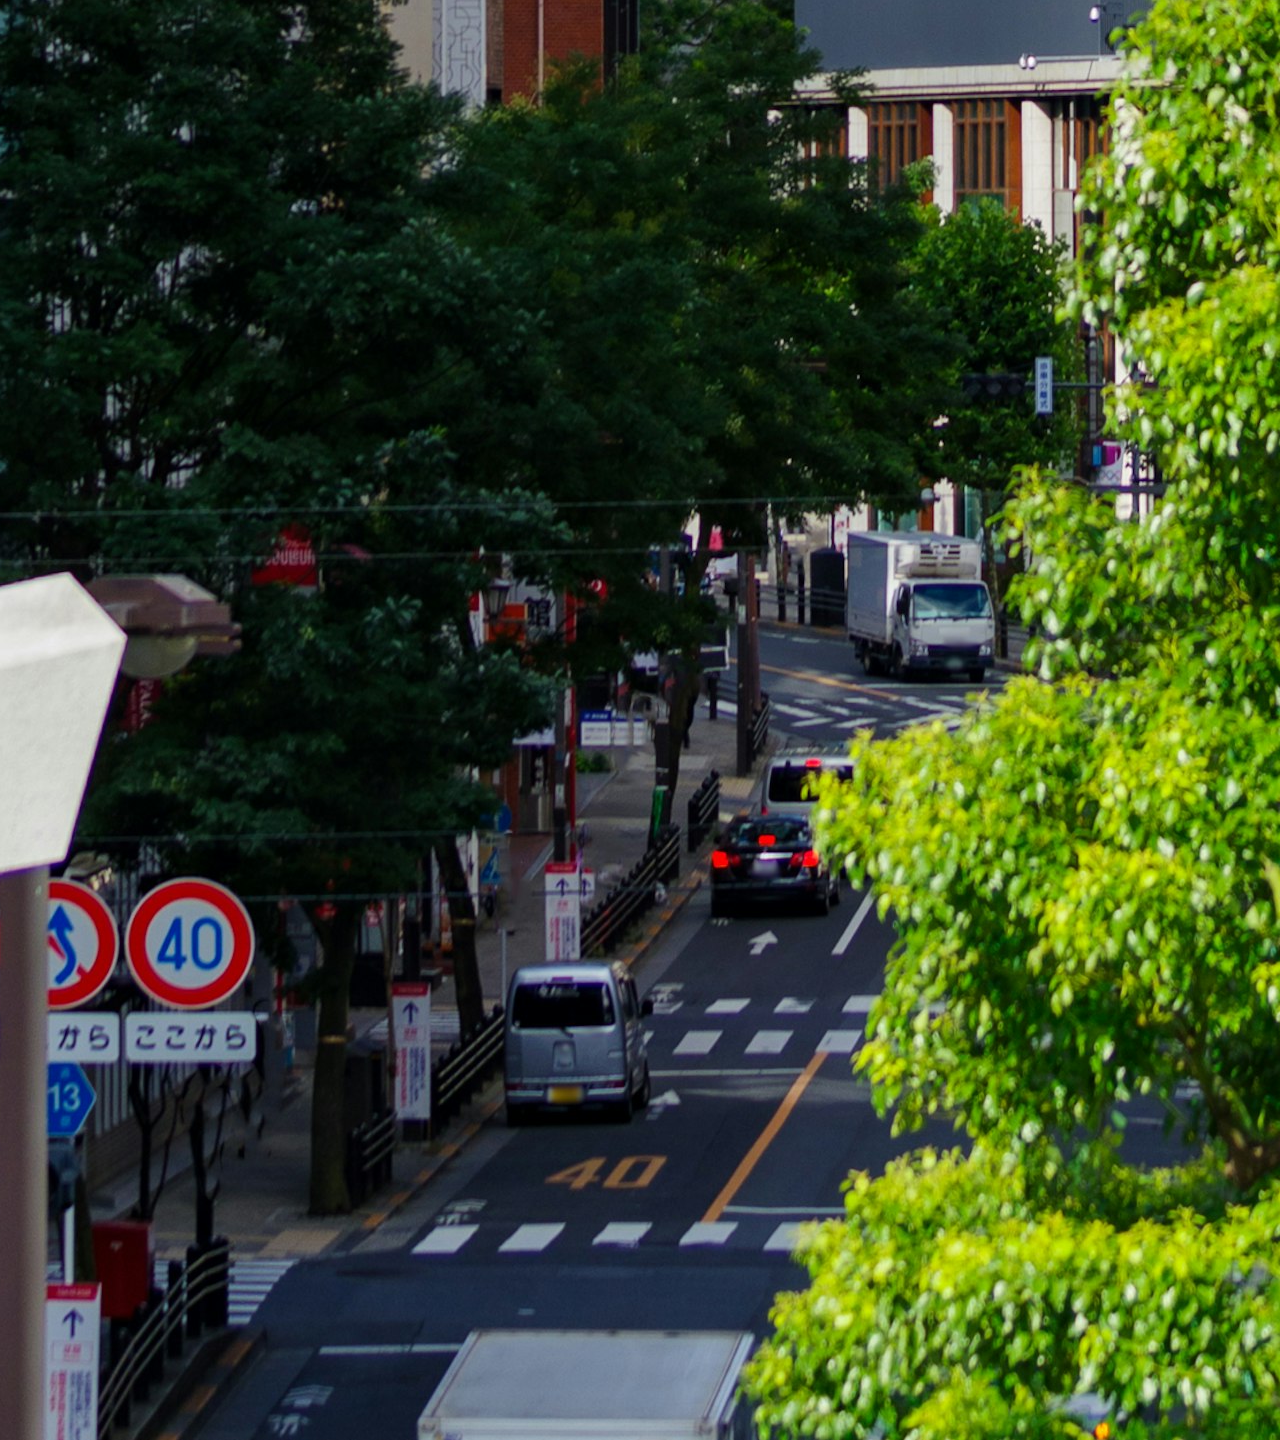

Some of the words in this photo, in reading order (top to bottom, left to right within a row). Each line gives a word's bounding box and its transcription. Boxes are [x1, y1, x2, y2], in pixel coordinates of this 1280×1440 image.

[156, 916, 224, 971] 40
[135, 1023, 247, 1050] ここから
[543, 1154, 668, 1190] 40
